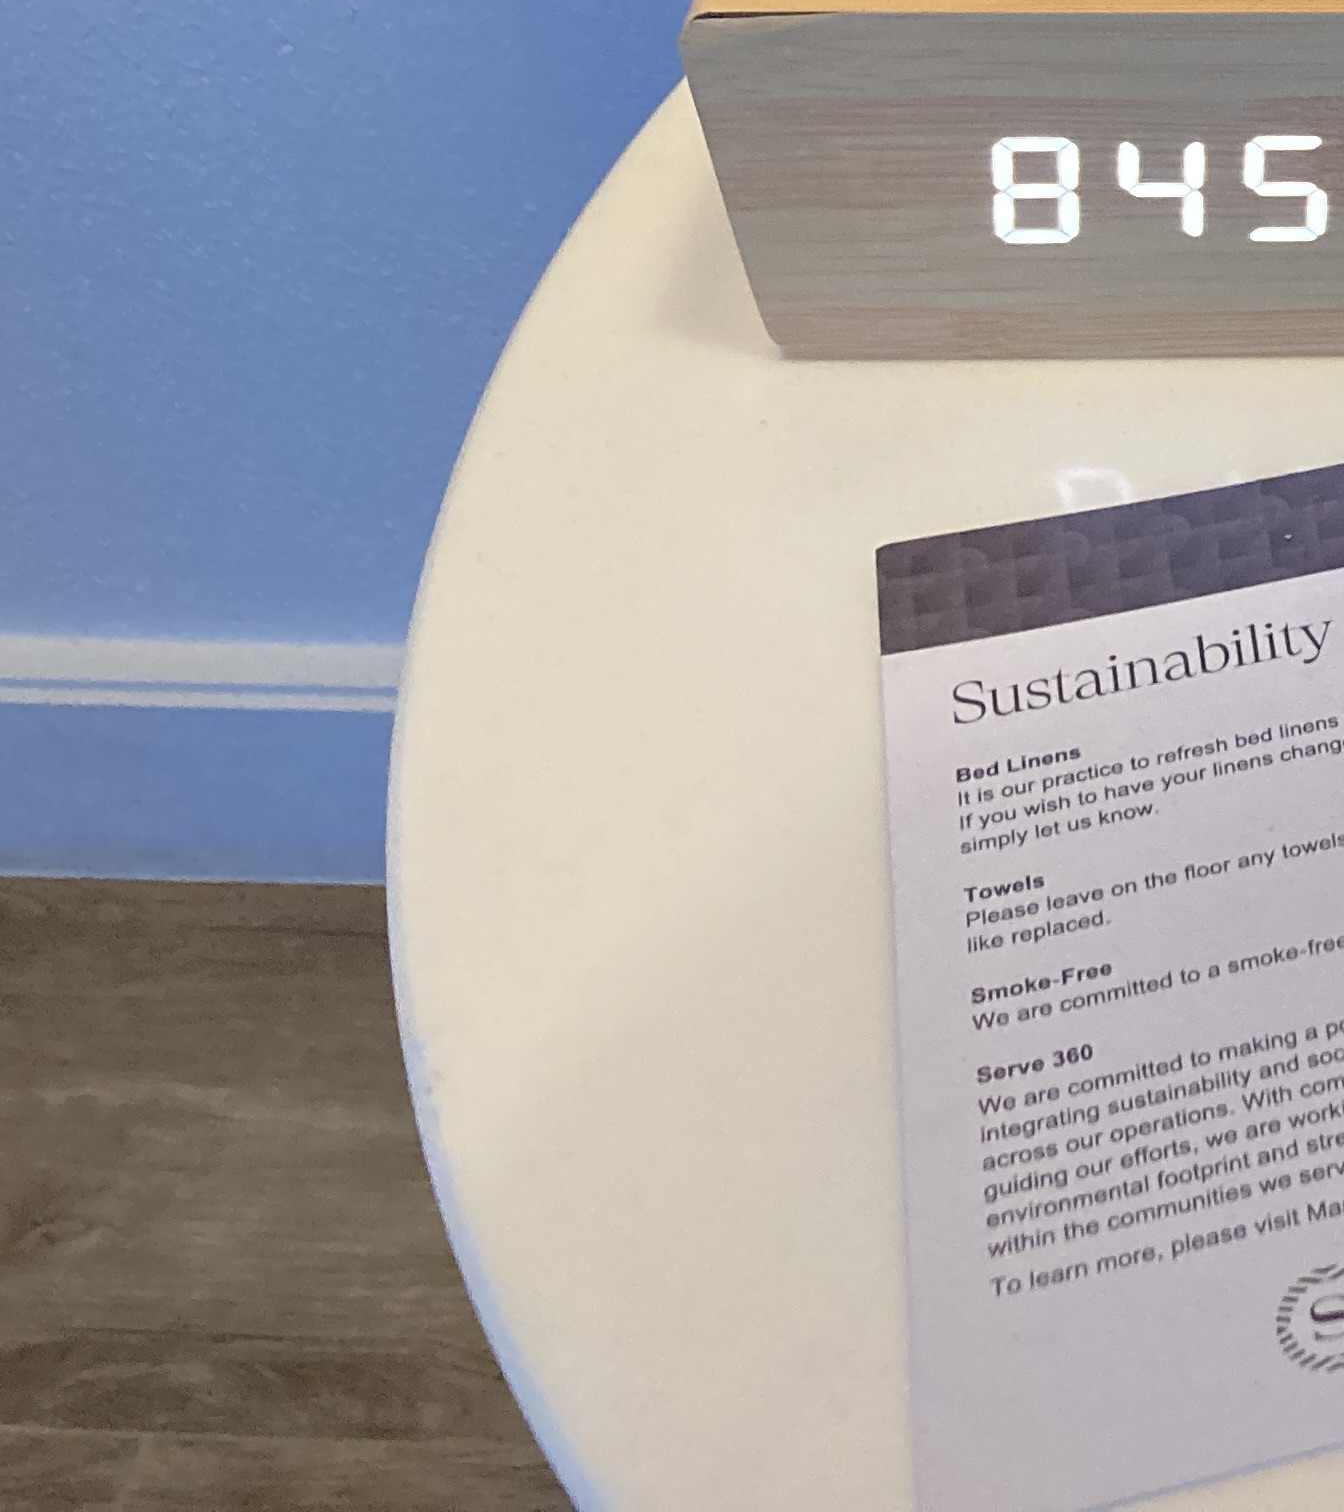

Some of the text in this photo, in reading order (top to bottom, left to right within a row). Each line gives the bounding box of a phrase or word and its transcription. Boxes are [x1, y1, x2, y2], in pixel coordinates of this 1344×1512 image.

[952, 619, 1335, 725] Sustainability
[955, 745, 1083, 784] Bed Linens
[957, 790, 971, 808] It
[976, 786, 996, 805] is
[999, 779, 1037, 799] our
[1041, 761, 1124, 792] practice
[1129, 754, 1150, 772] to
[1156, 737, 1229, 766] refresh
[1234, 726, 1273, 749] bed
[1278, 716, 1339, 740] linens
[959, 812, 974, 832] If
[977, 807, 1017, 830] you
[1022, 795, 1071, 819] wish
[1076, 790, 1098, 807] to
[1103, 779, 1155, 802] have
[1159, 767, 1208, 791] your
[1212, 753, 1274, 778] linens
[959, 802, 1160, 855] simply let us know.
[963, 874, 1045, 903] Towels
[965, 901, 1040, 929] Please
[1046, 887, 1105, 912] leave
[1110, 880, 1138, 898] on
[1143, 871, 1178, 891] the
[1183, 859, 1232, 882] floor
[1237, 848, 1276, 871] any
[966, 908, 1112, 955] like replaced.
[970, 962, 1113, 1006] Smoke-Free
[971, 1009, 1010, 1032] We
[1016, 1001, 1053, 1023] are
[1059, 970, 1173, 1013] committed
[1179, 967, 1201, 986] to
[1207, 964, 1221, 980] a
[975, 1043, 1094, 1086] Serve 360
[977, 1094, 1017, 1118] We
[1023, 1086, 1061, 1108] are
[1067, 1051, 1183, 1098] committed
[1190, 1048, 1212, 1070] to
[1218, 1030, 1298, 1063] making
[1304, 1024, 1319, 1042] a
[980, 1104, 1101, 1145] integrating
[1107, 1068, 1252, 1117] sustainability
[1258, 1053, 1300, 1080] and
[982, 1142, 1059, 1173] across
[1065, 1131, 1104, 1155] our
[1109, 1103, 1236, 1144] operations.
[1241, 1085, 1293, 1113] With
[983, 1168, 1069, 1204] guiding
[1075, 1156, 1114, 1182] our
[1119, 1137, 1199, 1171] efforts,
[1204, 1128, 1238, 1151] we
[1245, 1118, 1282, 1142] are
[985, 1173, 1150, 1231] environmental
[1156, 1150, 1252, 1190] footprint
[1257, 1138, 1300, 1167] and
[986, 1228, 1057, 1260] within
[1063, 1218, 1100, 1242] the
[1106, 1183, 1253, 1232] communities
[1258, 1173, 1293, 1196] we
[988, 1276, 1024, 1299] To
[1029, 1261, 1090, 1292] learn
[1095, 1245, 1164, 1275] more,
[1170, 1223, 1248, 1259] please
[1253, 1207, 1302, 1237] visit
